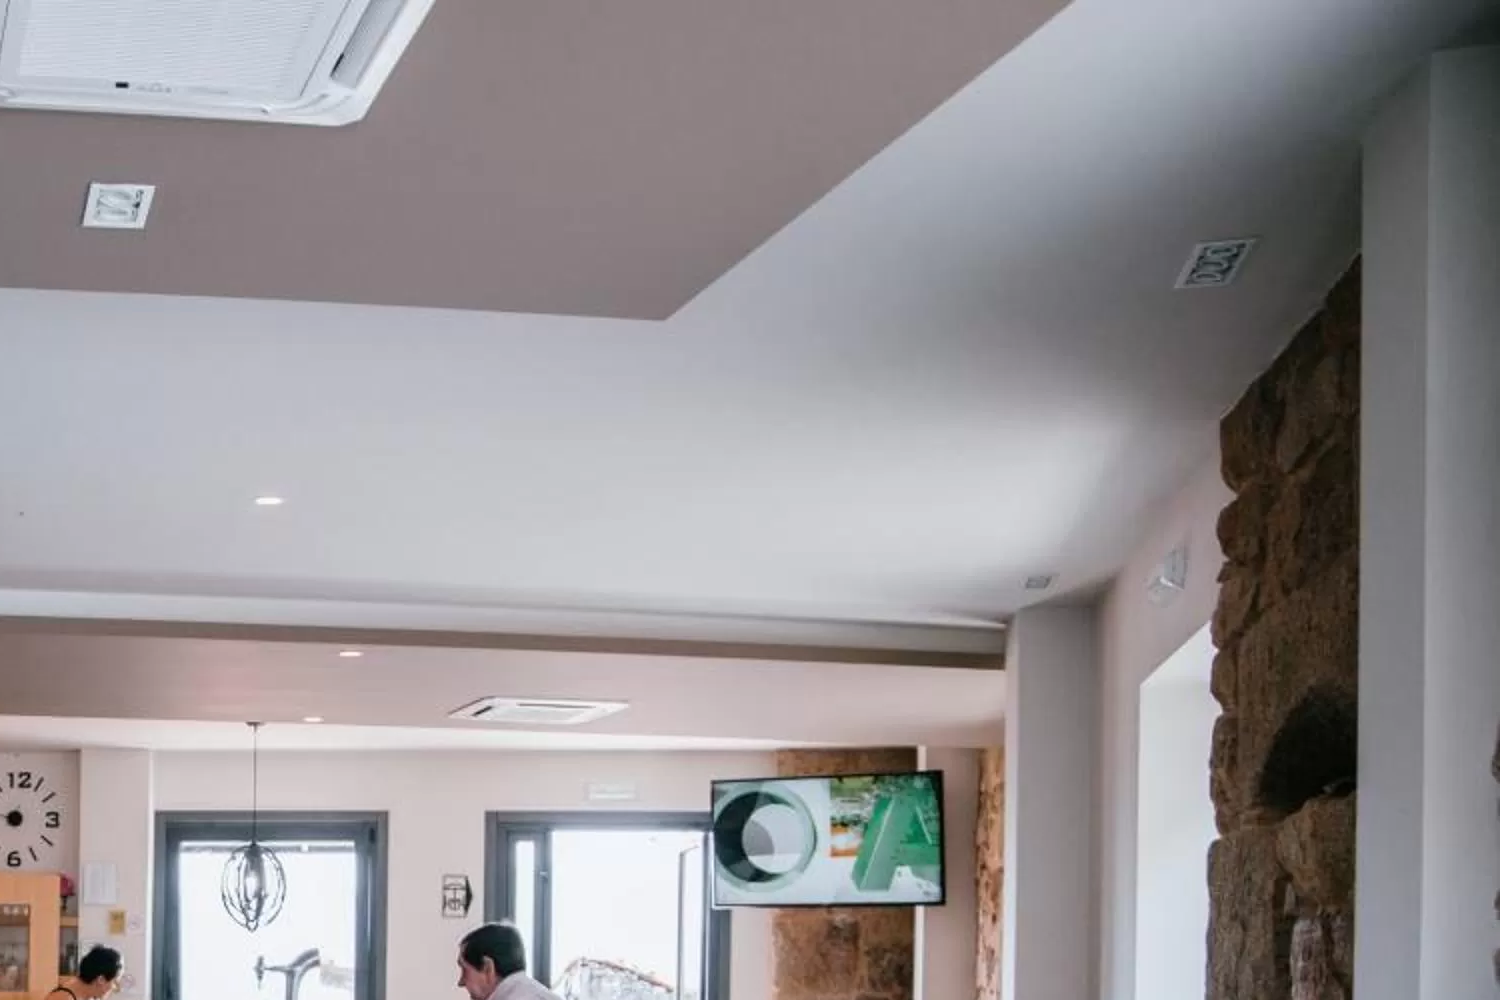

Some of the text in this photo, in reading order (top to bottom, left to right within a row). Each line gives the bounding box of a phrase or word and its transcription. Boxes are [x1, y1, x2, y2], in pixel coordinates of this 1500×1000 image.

[7, 771, 32, 789] 12
[45, 811, 60, 829] 3
[6, 850, 22, 868] 6
